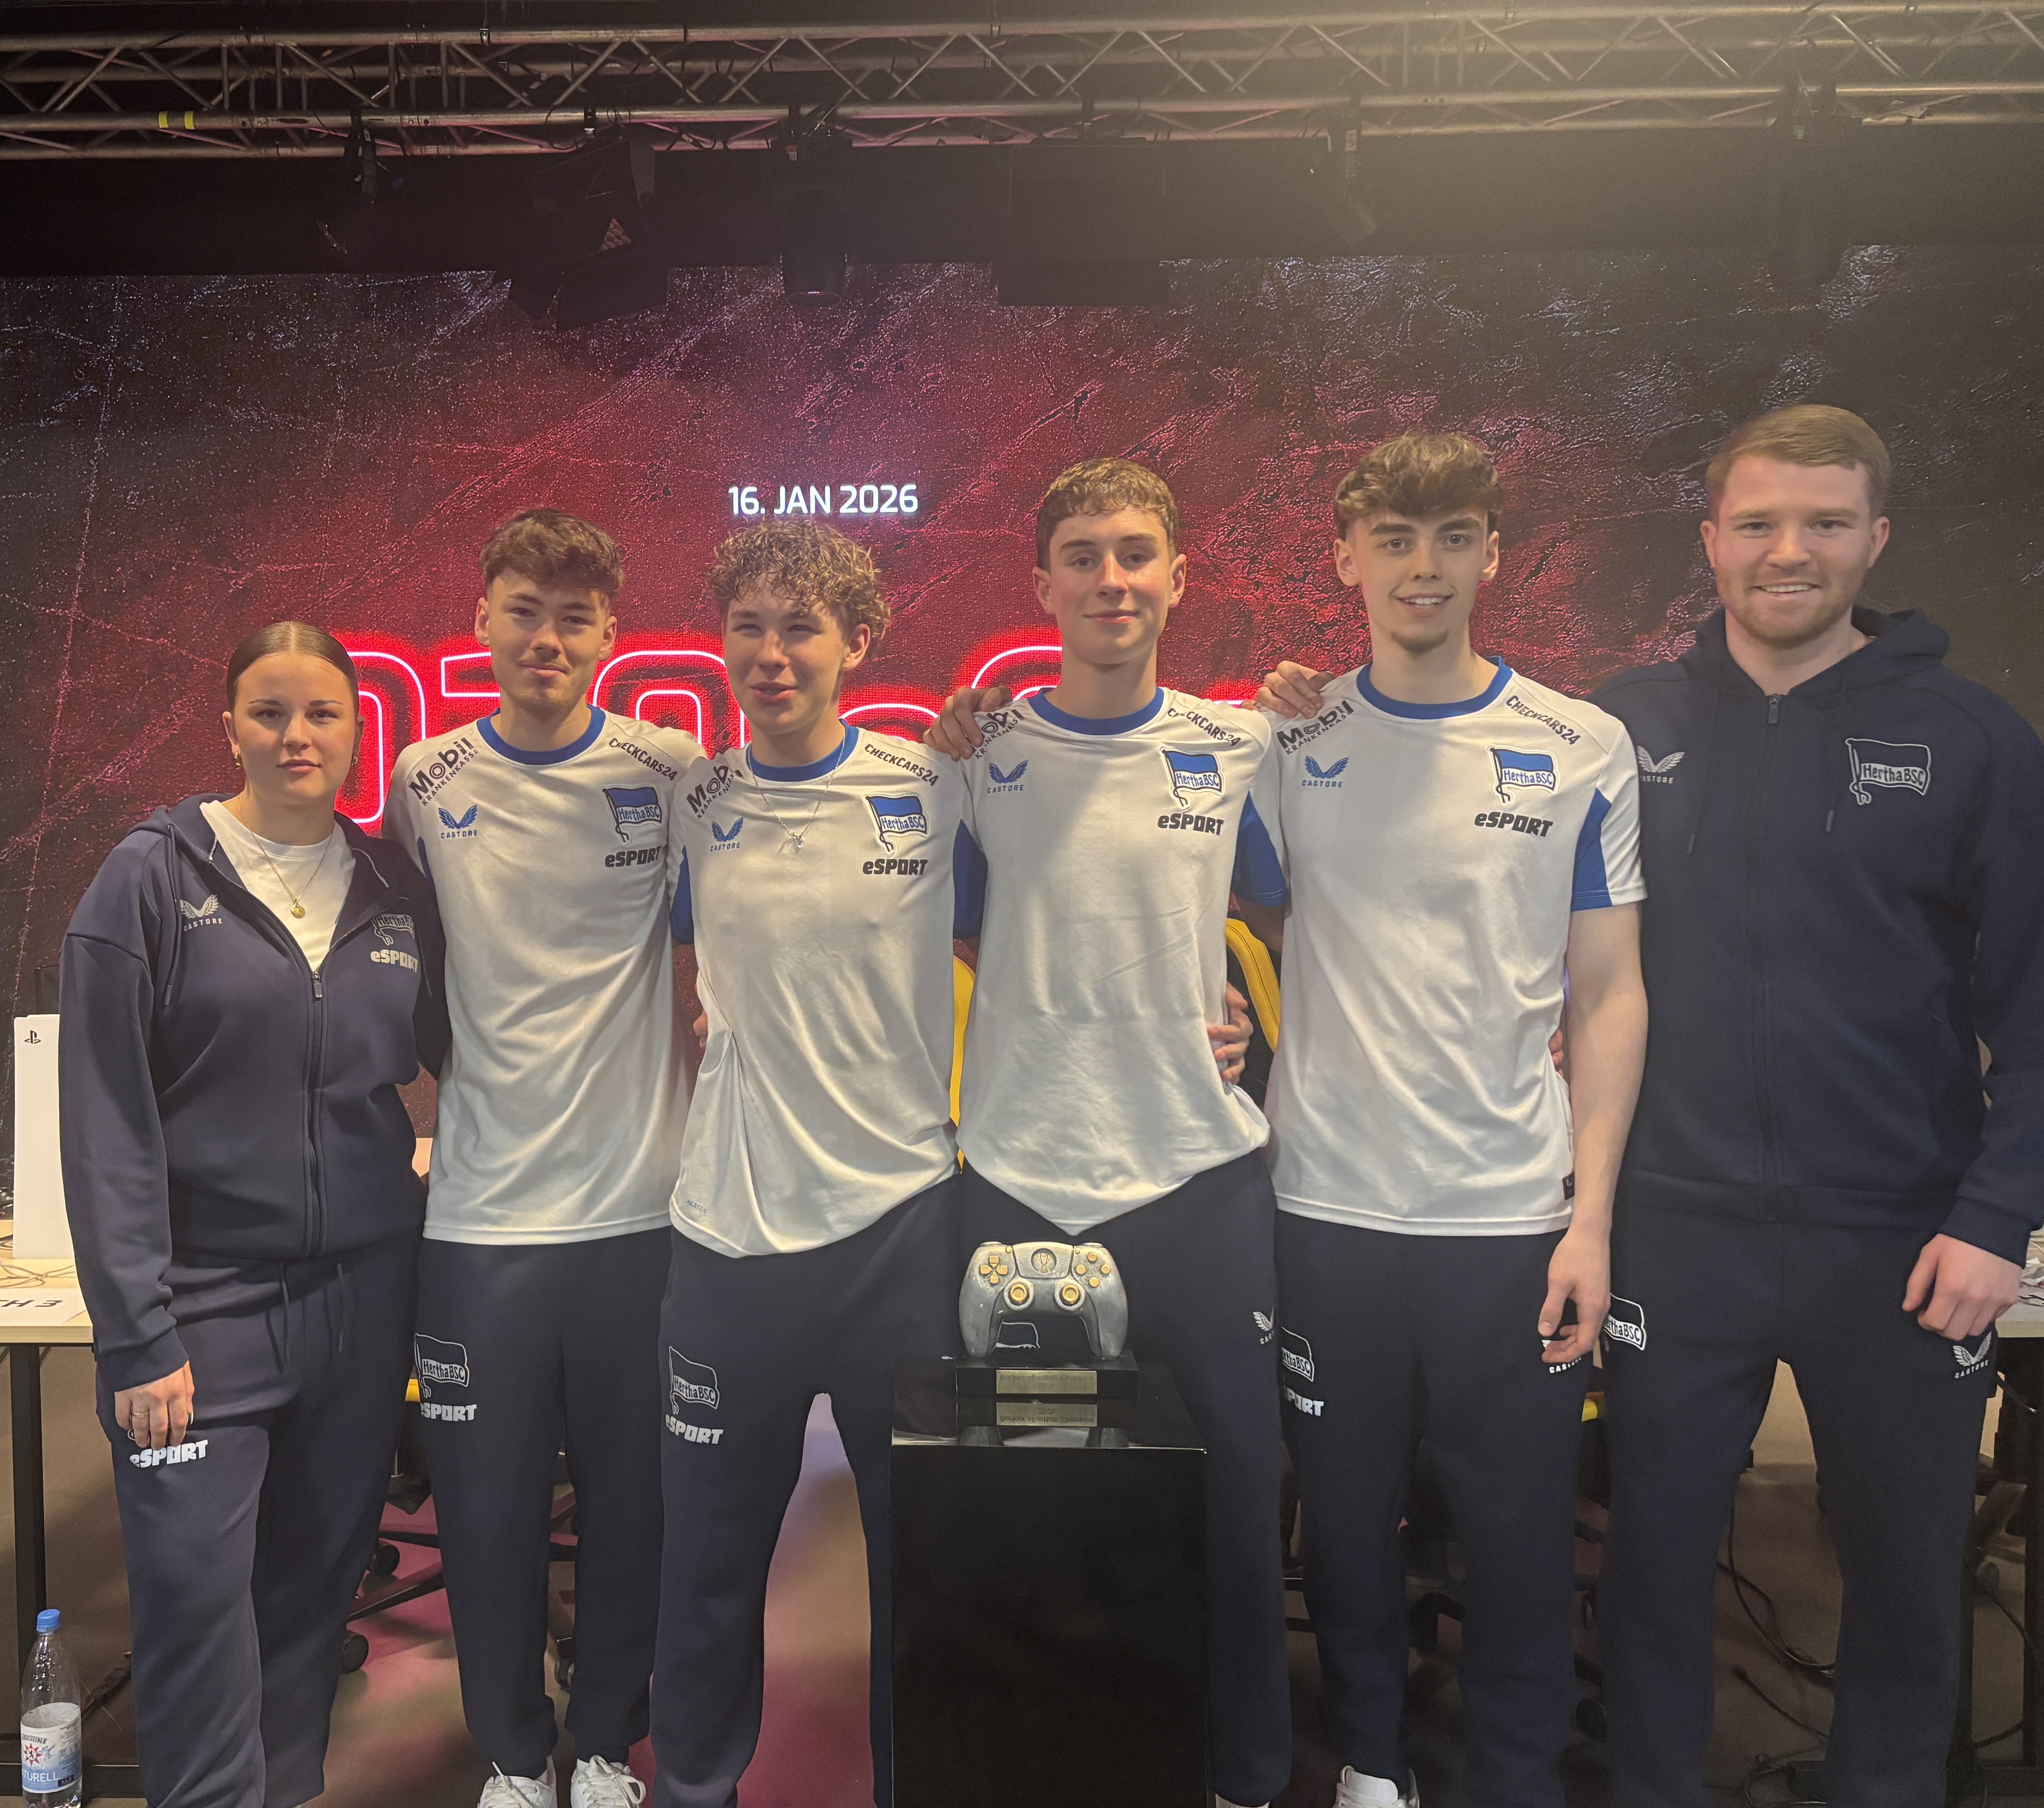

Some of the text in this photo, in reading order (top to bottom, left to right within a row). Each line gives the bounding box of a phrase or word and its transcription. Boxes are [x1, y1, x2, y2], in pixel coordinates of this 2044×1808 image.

[728, 485, 918, 514] 16. JAN 2026
[1506, 695, 1581, 745] CHECKCARS24
[1286, 713, 1346, 755] KRANKENKAS
[409, 738, 474, 800] Mobil
[609, 738, 677, 781] CHECKCARS24
[864, 744, 939, 786] CHECKCARS24
[422, 749, 478, 806] KRANKENKASSE
[987, 784, 1024, 794] CASTORE
[1640, 776, 1674, 784] ASTORE
[697, 773, 734, 819] KRANKENKAS
[441, 830, 478, 839] CASTORE
[1158, 813, 1224, 836] eSPORT
[1474, 811, 1554, 837] eSPORT
[605, 845, 662, 867] eSPORT
[710, 842, 740, 852] CASTORE
[863, 859, 928, 876] eSPORT
[184, 918, 223, 931] CASTORE
[370, 949, 419, 973] eSPORT
[129, 1439, 208, 1468] eSPORT
[22, 1769, 59, 1782] TURELL
